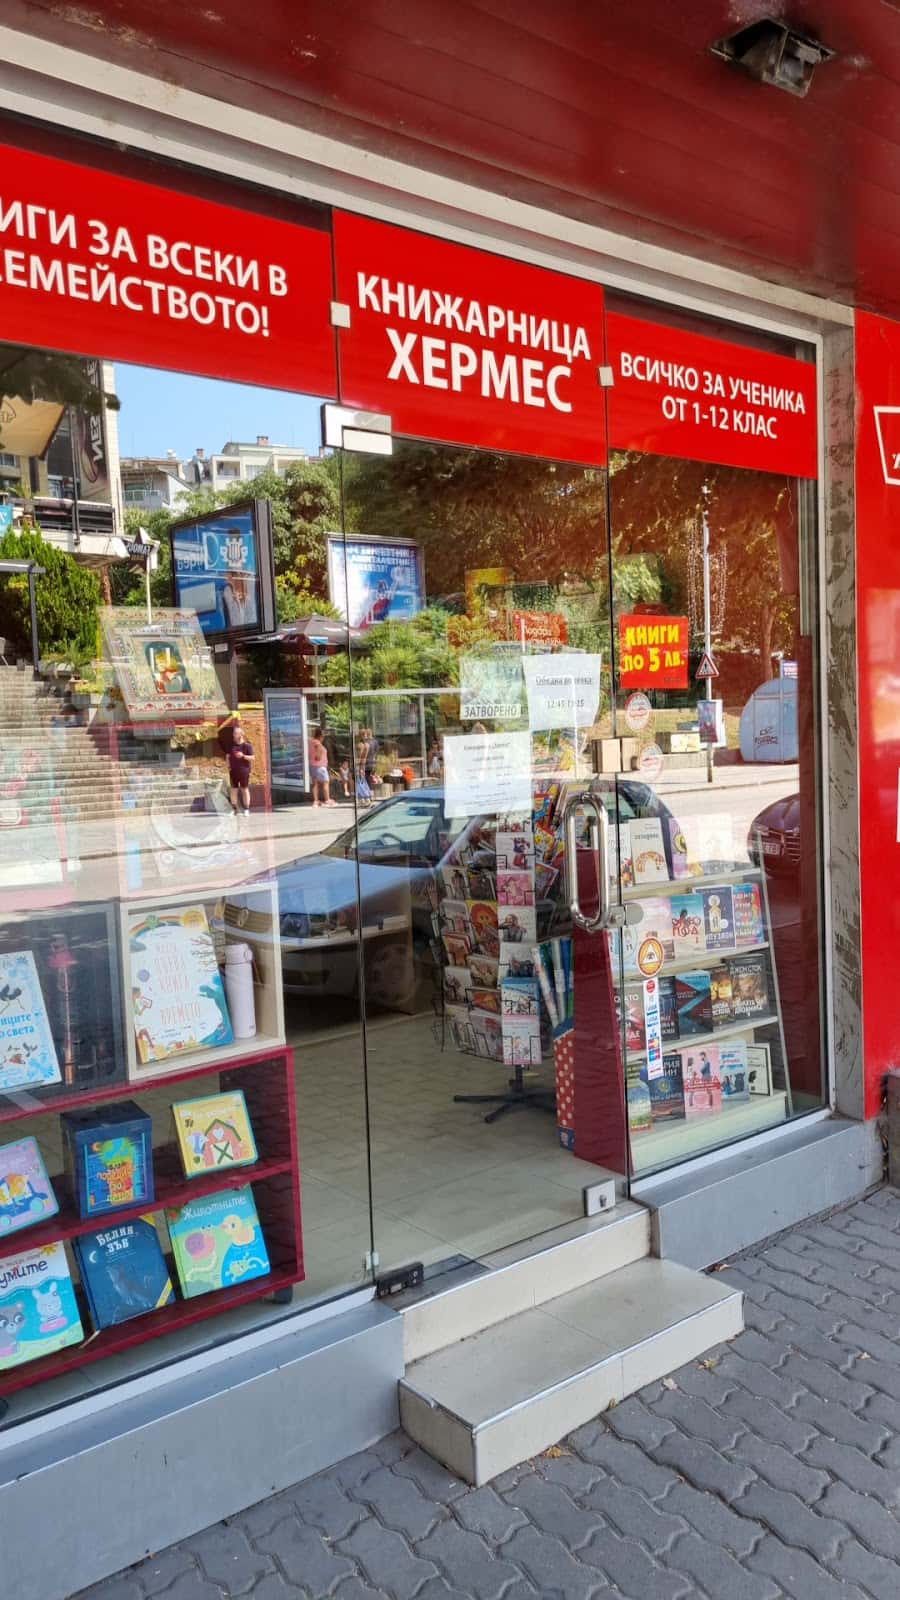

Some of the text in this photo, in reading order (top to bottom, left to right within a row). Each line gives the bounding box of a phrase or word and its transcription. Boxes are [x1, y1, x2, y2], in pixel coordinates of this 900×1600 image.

[88, 220, 138, 263] ЗА
[147, 234, 259, 291] ВСЕКИ
[268, 264, 289, 297] В
[0, 249, 270, 338] ЕМЕЙСТВОТО!
[357, 271, 592, 363] КНИЖАРНИЦА
[386, 327, 572, 414] ХЕРМЕС
[620, 352, 806, 414] ВСИЧКО ЗА УЧЕНИКА
[662, 395, 779, 440] ОТ 1-12 КЛАС
[624, 624, 680, 648] КНИГИ
[648, 647, 661, 672] 5
[463, 703, 518, 718] ЗАТВОРЕНО
[183, 1195, 249, 1221] Животните
